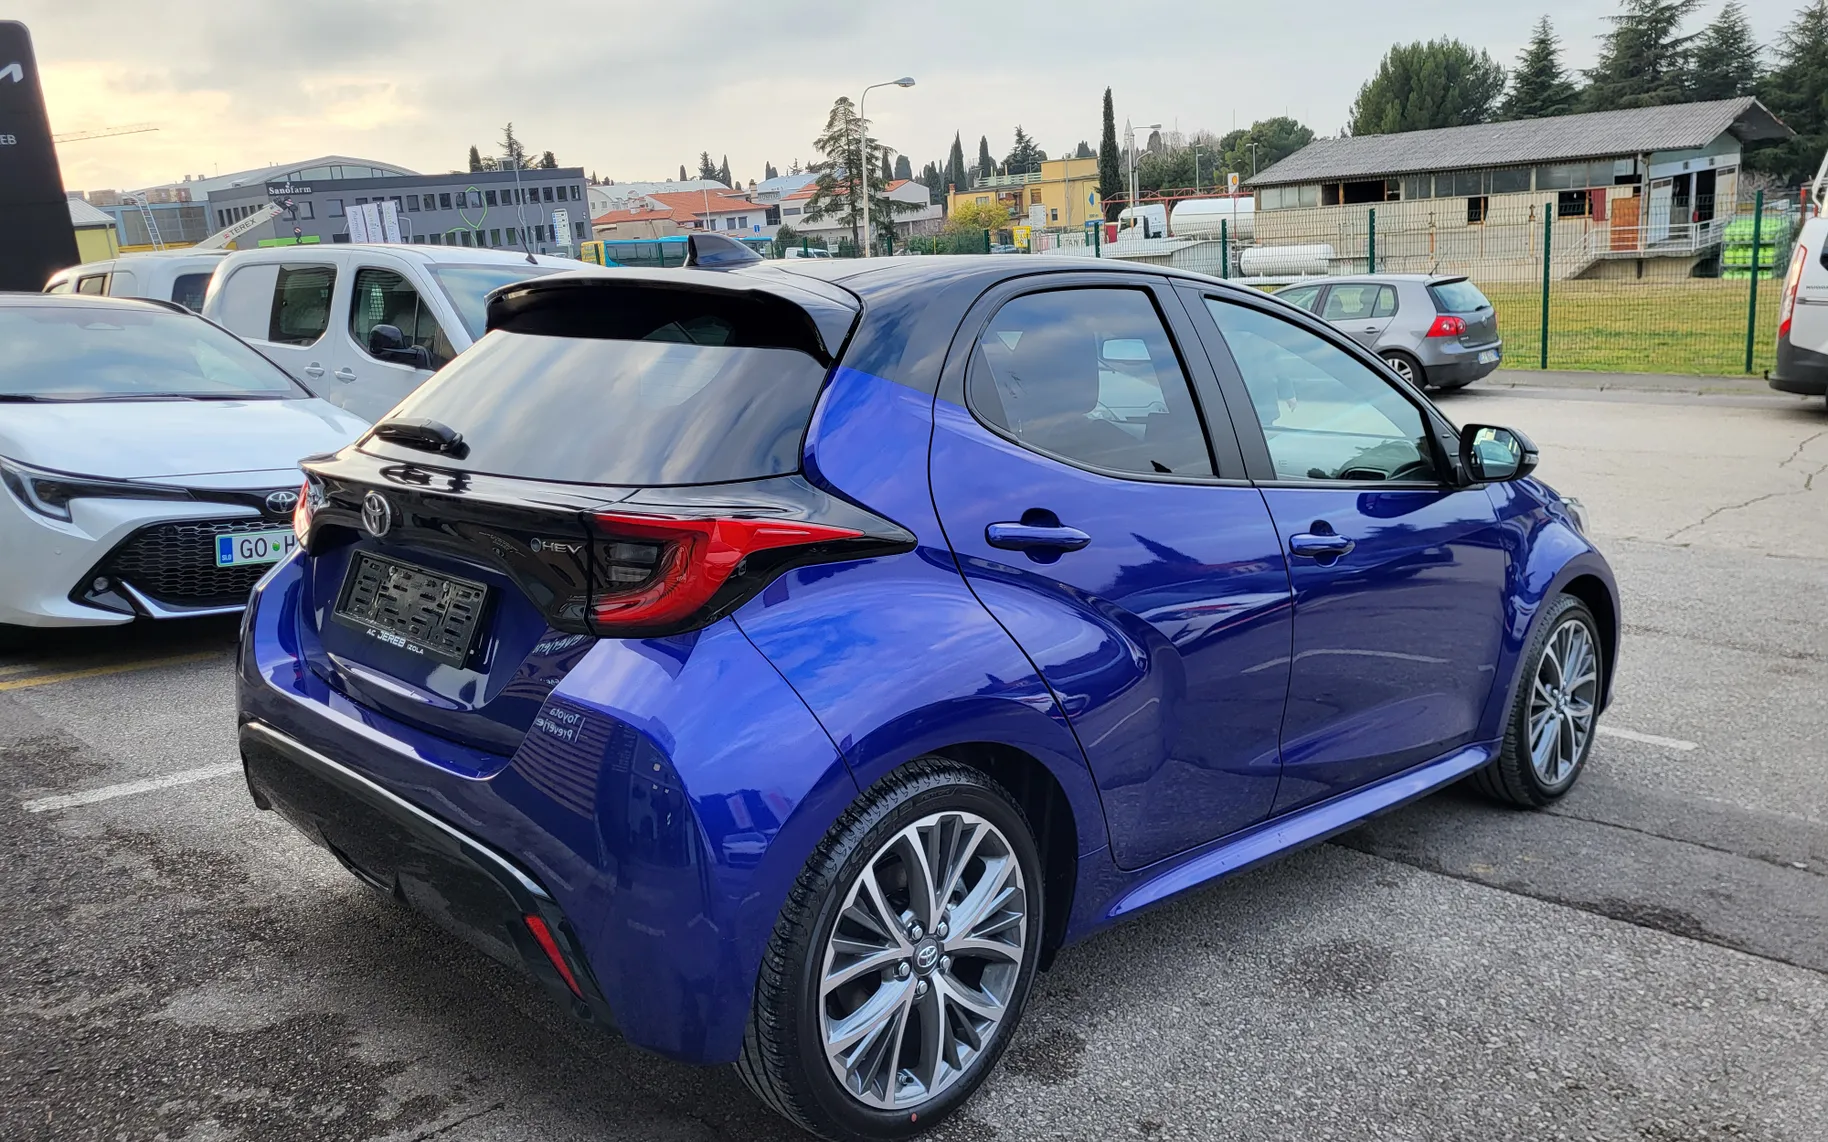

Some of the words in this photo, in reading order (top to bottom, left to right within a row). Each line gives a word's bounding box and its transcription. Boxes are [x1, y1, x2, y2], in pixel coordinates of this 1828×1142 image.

[0, 134, 17, 145] EB
[268, 186, 312, 195] Sanofarm
[229, 218, 257, 236] TEREX
[240, 538, 268, 559] GO
[542, 541, 582, 554] HEV
[366, 628, 377, 636] AC
[377, 631, 406, 648] JEREB
[406, 644, 424, 655] IZOLA
